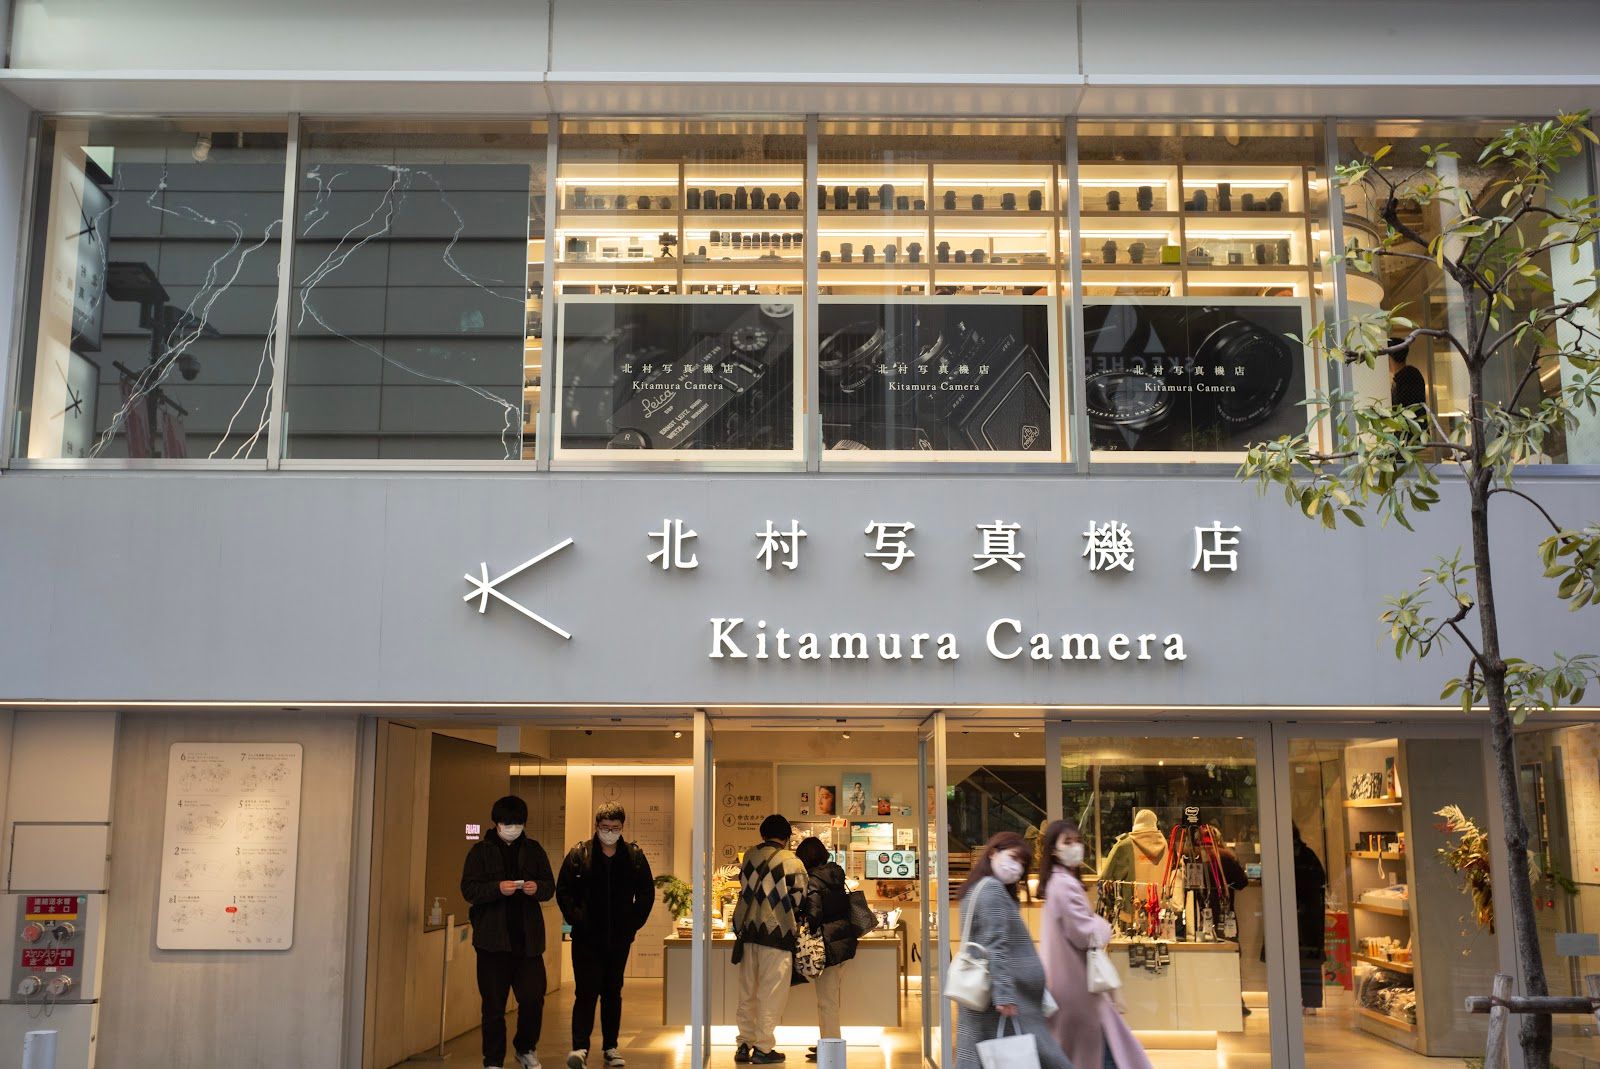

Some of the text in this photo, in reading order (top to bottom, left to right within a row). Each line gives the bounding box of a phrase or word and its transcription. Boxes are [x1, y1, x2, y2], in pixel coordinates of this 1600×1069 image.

[622, 363, 735, 374] 北村写真機店
[878, 364, 990, 375] 北村写真機店
[1133, 365, 1245, 376] 北村写真機店
[632, 381, 724, 390] Kitamura Camera
[888, 382, 980, 391] Kitamura Camera
[1144, 383, 1236, 392] Kitamura Camera
[642, 390, 677, 418] Leica
[659, 420, 677, 435] ERNST
[675, 409, 691, 421] LEITZ
[666, 419, 691, 439] WETZLAR
[647, 519, 1241, 572] 北村写真機店
[709, 617, 1187, 662] Kitamura Camera
